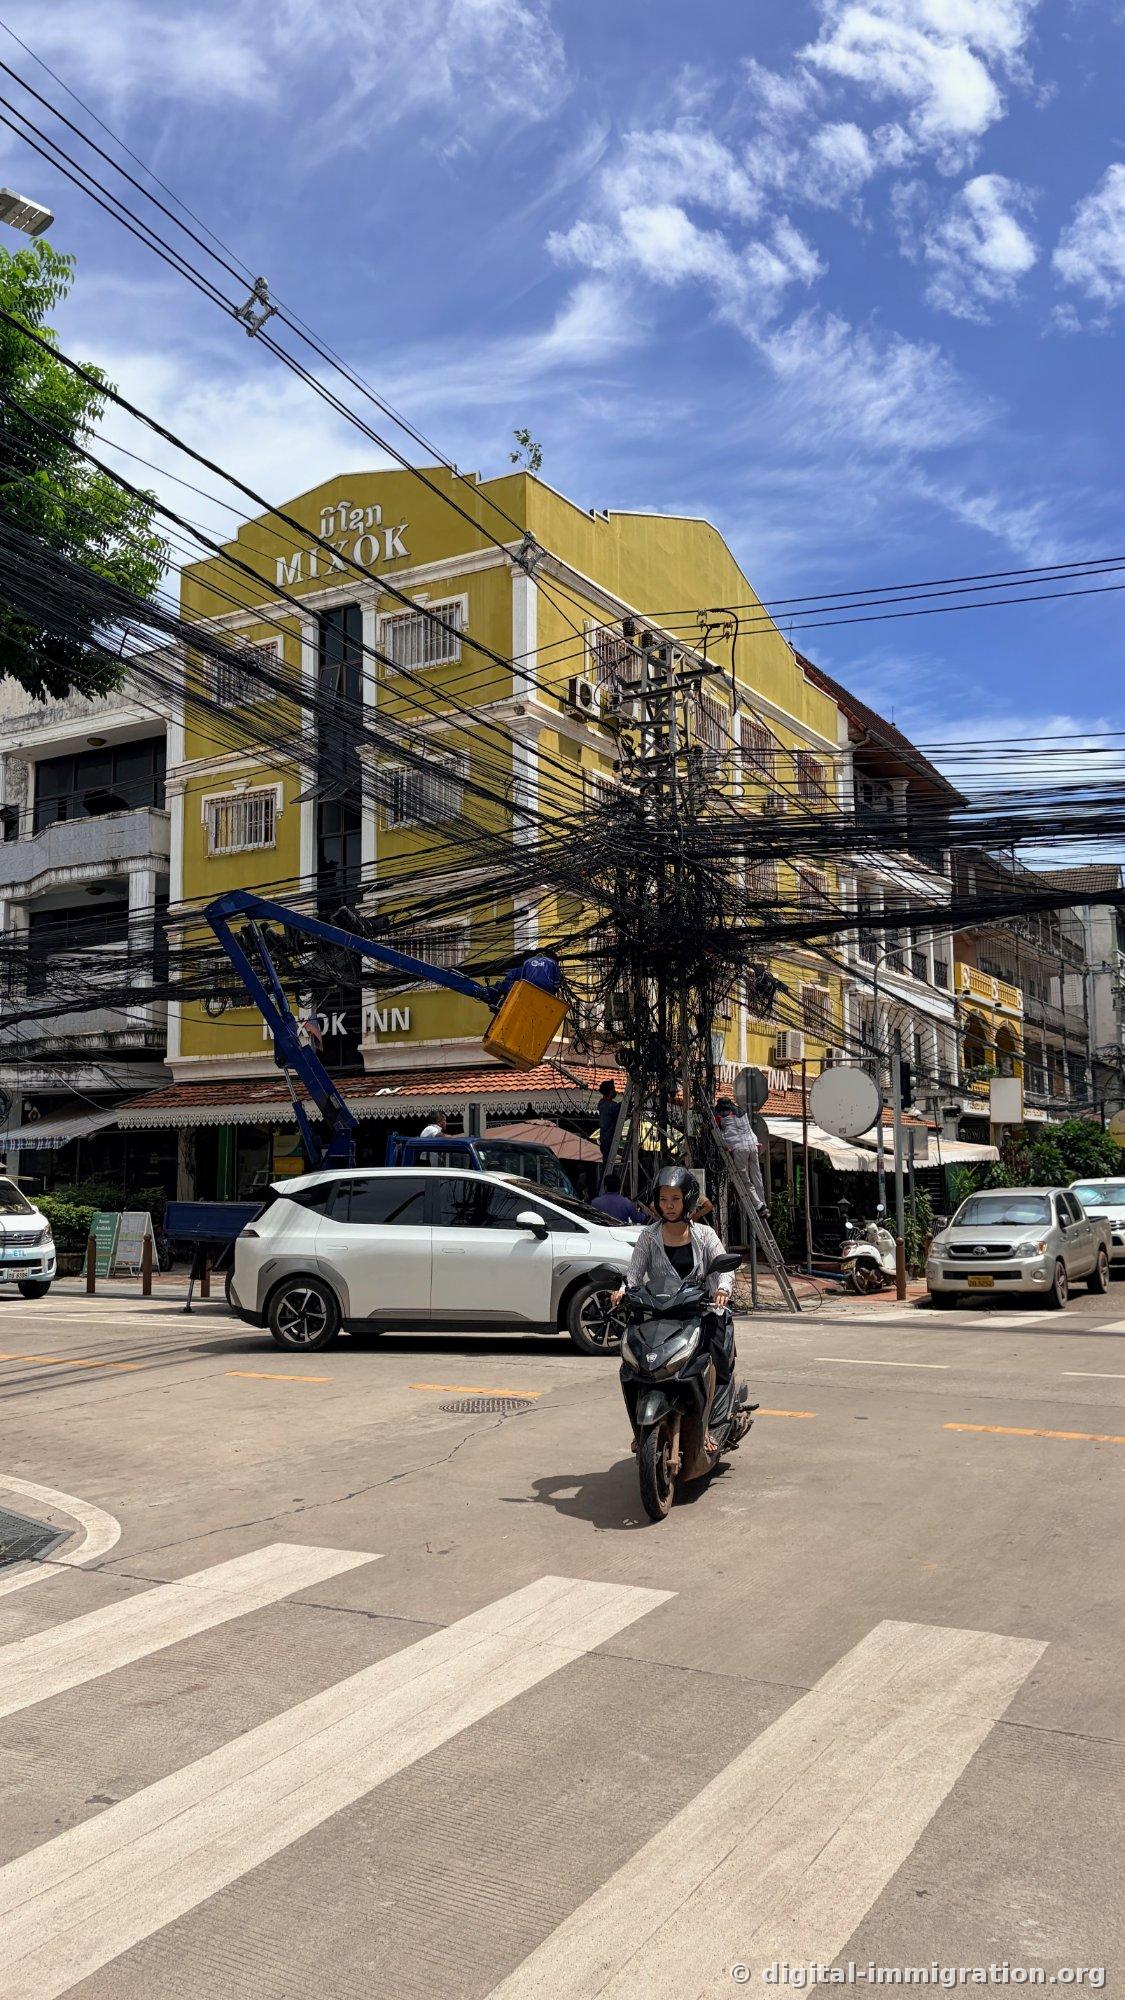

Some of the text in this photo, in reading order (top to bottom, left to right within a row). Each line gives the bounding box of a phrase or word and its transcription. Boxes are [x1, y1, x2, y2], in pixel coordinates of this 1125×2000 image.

[275, 523, 410, 587] MIXOK
[361, 1006, 410, 1032] INN
[767, 1067, 789, 1091] INN
